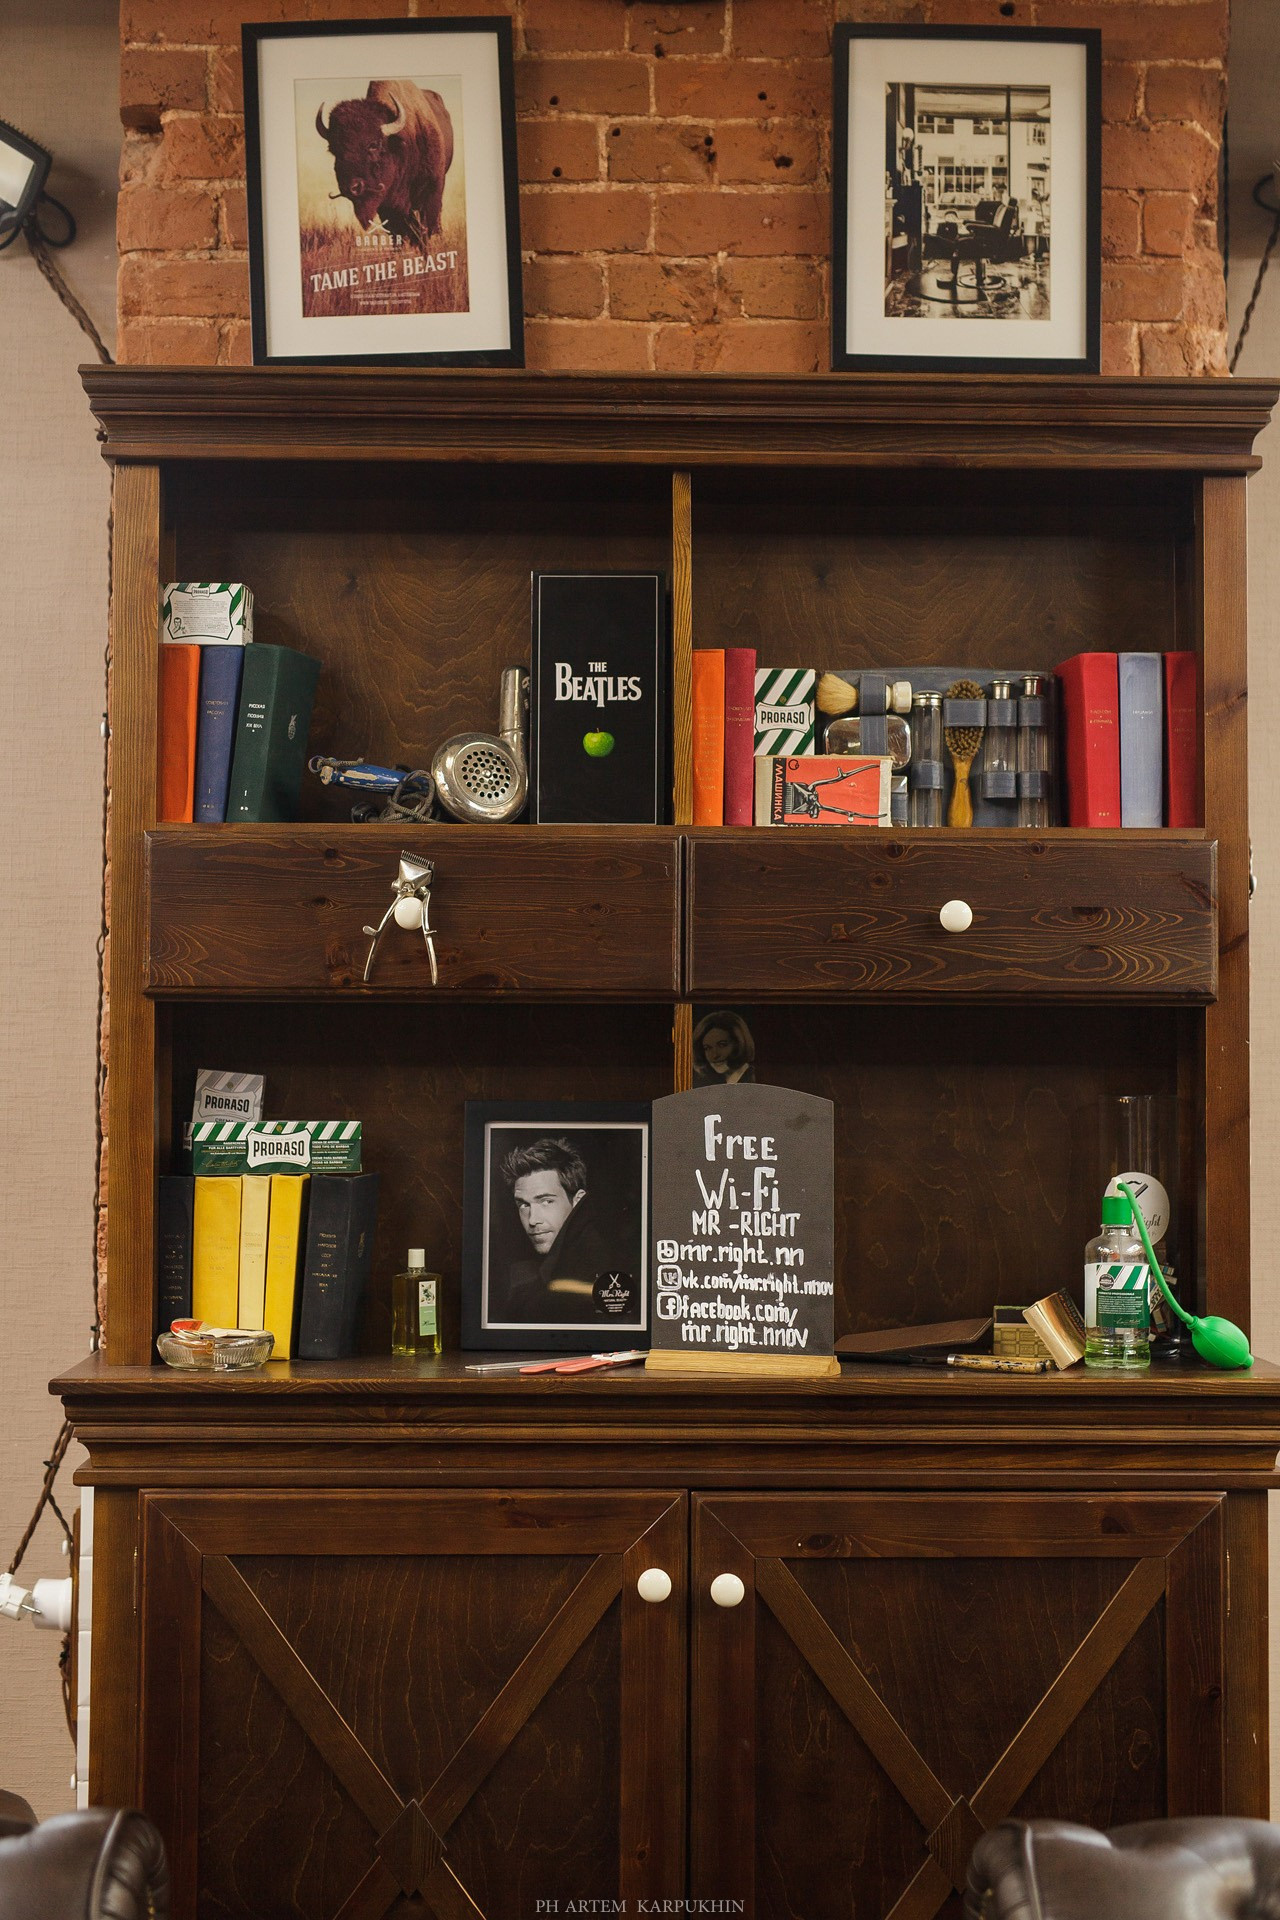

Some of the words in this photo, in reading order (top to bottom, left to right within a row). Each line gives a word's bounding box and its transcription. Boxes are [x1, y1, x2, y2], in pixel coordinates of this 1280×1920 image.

[356, 234, 402, 246] BARBER
[310, 267, 359, 293] TAME
[362, 261, 398, 283] THE
[402, 251, 458, 277] BEAST
[588, 661, 608, 673] THE
[554, 662, 642, 708] BEATLES
[761, 710, 805, 725] PRORASO
[773, 763, 784, 821] МАШИНКА
[204, 1094, 250, 1113] PRORASO
[253, 1140, 305, 1157] PRORASO
[695, 1166, 780, 1212] Wi-Fi
[692, 1210, 721, 1236] MR
[680, 1238, 805, 1274] mr.right.nn
[681, 1319, 809, 1350] mr.right.nnov
